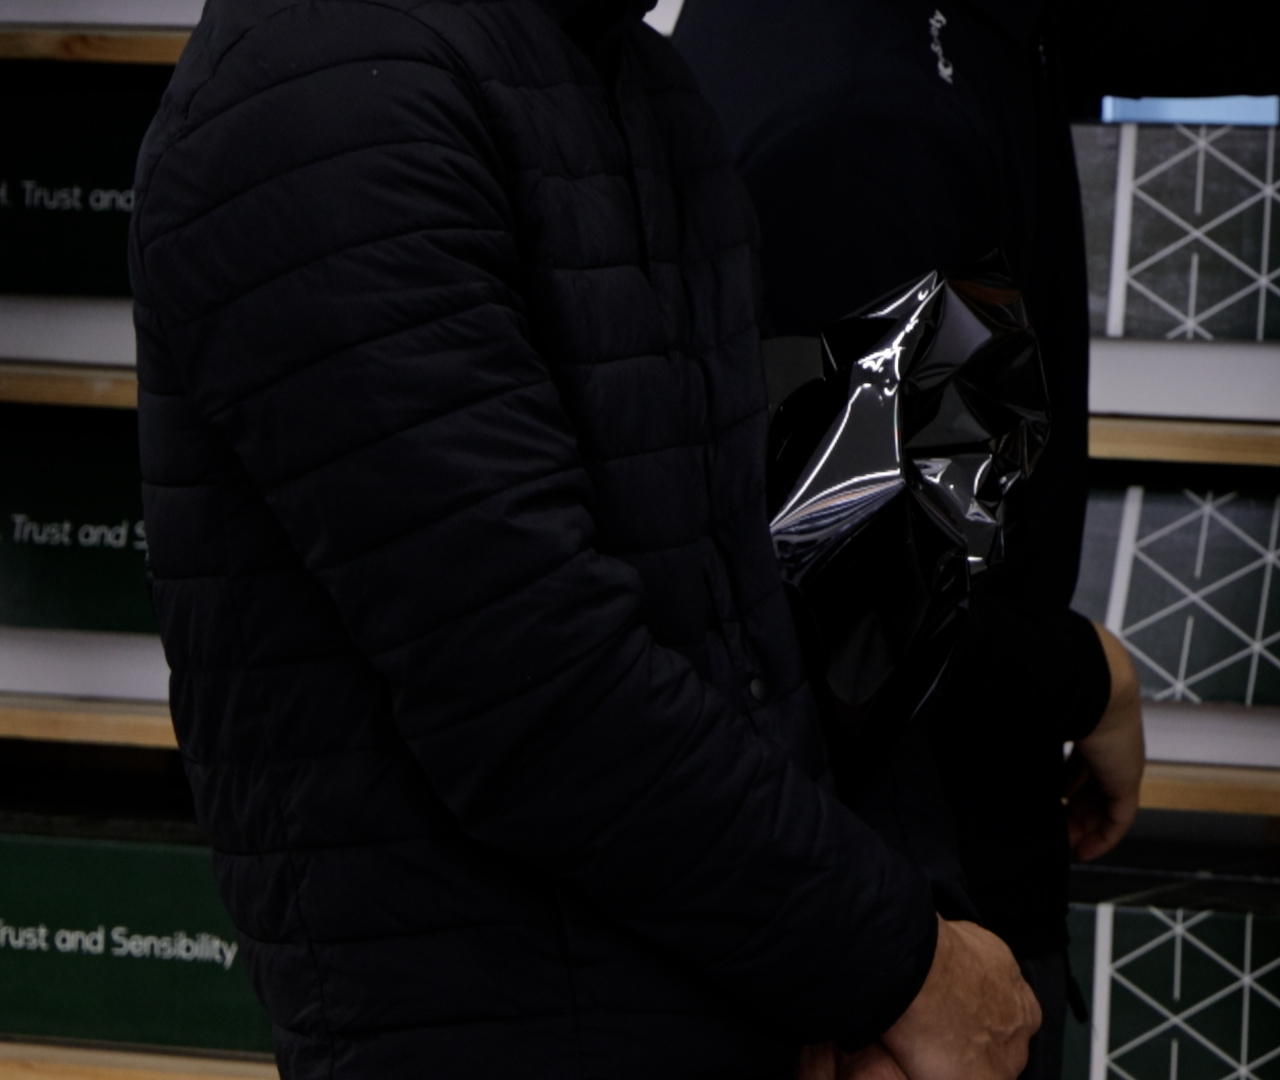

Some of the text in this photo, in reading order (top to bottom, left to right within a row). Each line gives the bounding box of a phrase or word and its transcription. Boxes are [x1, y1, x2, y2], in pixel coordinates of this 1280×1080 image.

[21, 179, 83, 211] Trust
[11, 513, 73, 547] Trust
[78, 518, 129, 549] and
[0, 918, 239, 971] rust and Sensibility
